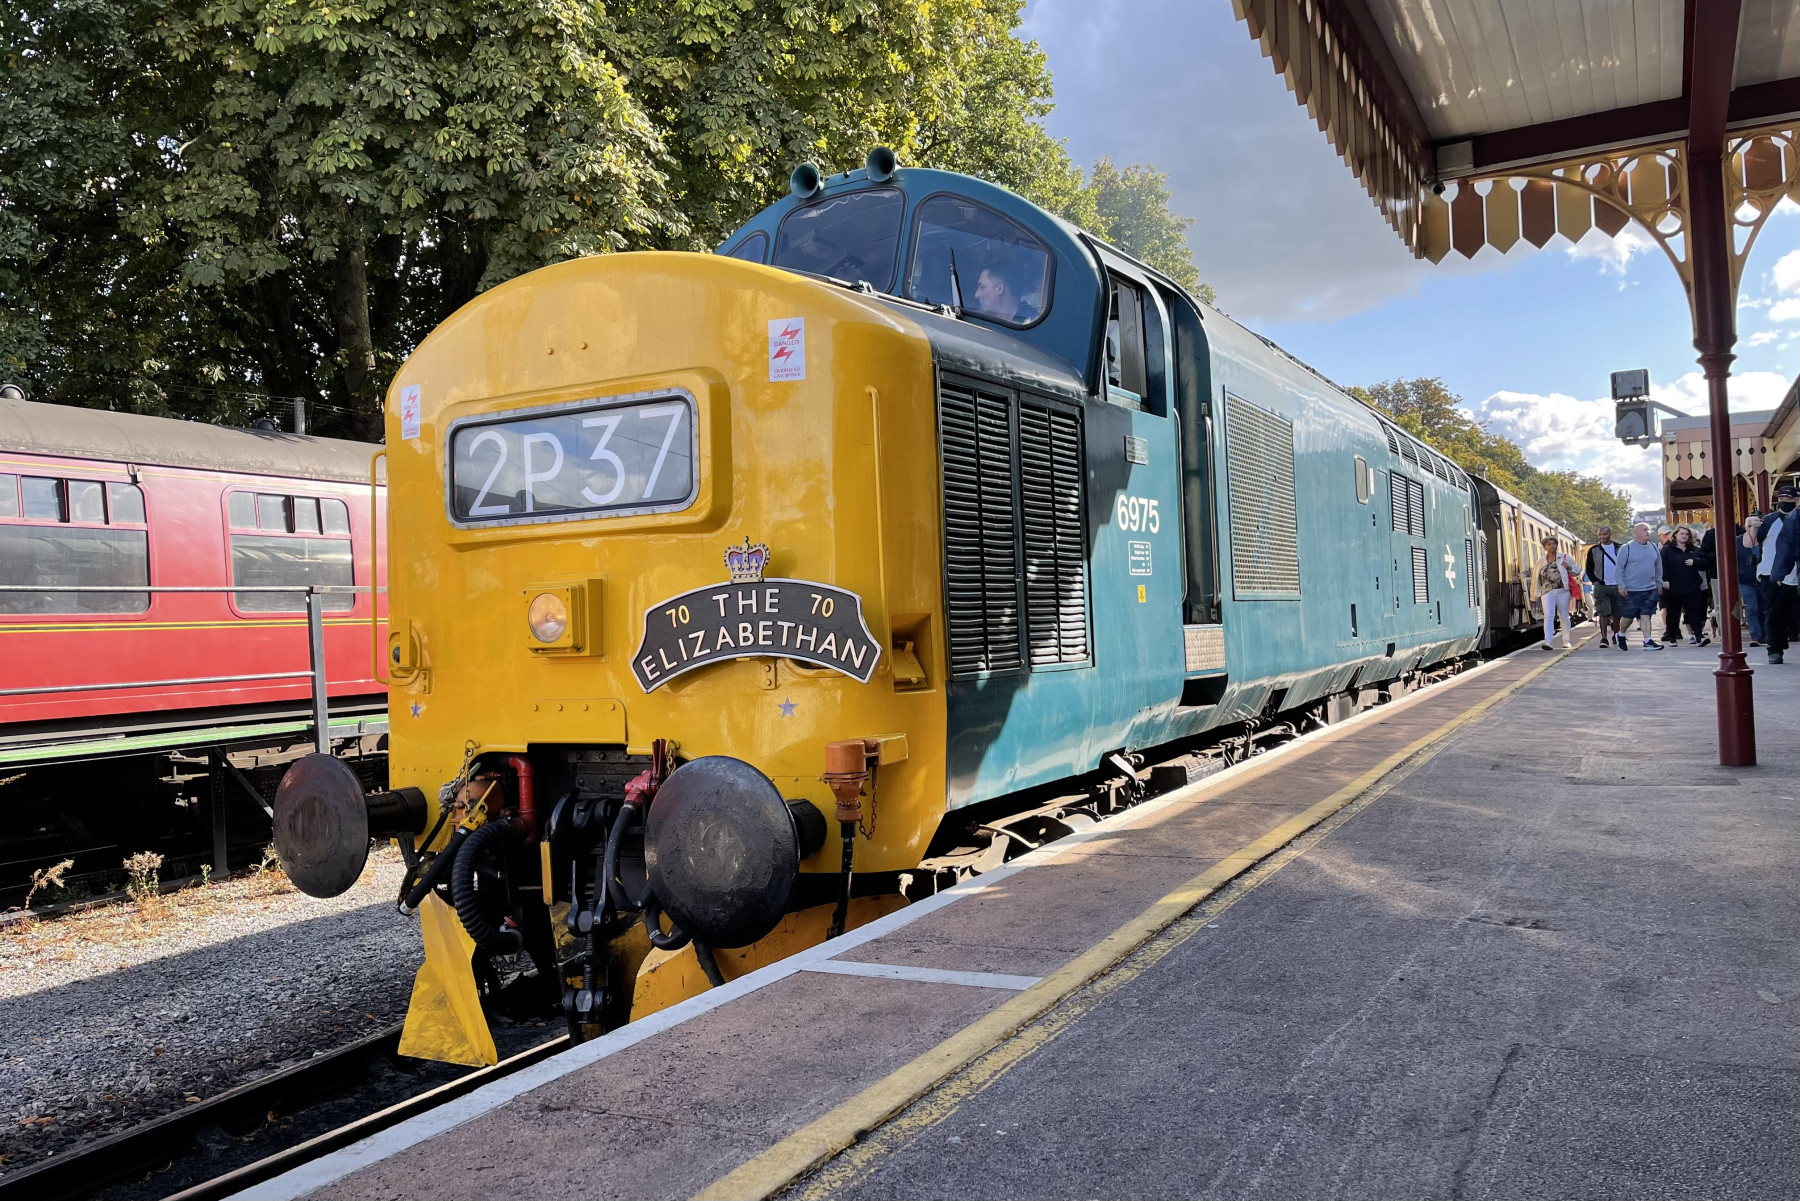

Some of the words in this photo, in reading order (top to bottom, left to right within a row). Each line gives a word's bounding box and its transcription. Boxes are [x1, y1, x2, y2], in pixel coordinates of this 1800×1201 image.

[774, 339, 800, 347] DANGER
[1117, 494, 1160, 533] 6975
[665, 605, 690, 628] 70
[712, 588, 780, 617] THE
[810, 593, 834, 618] 70
[640, 620, 868, 681] ELIZABETHAN
